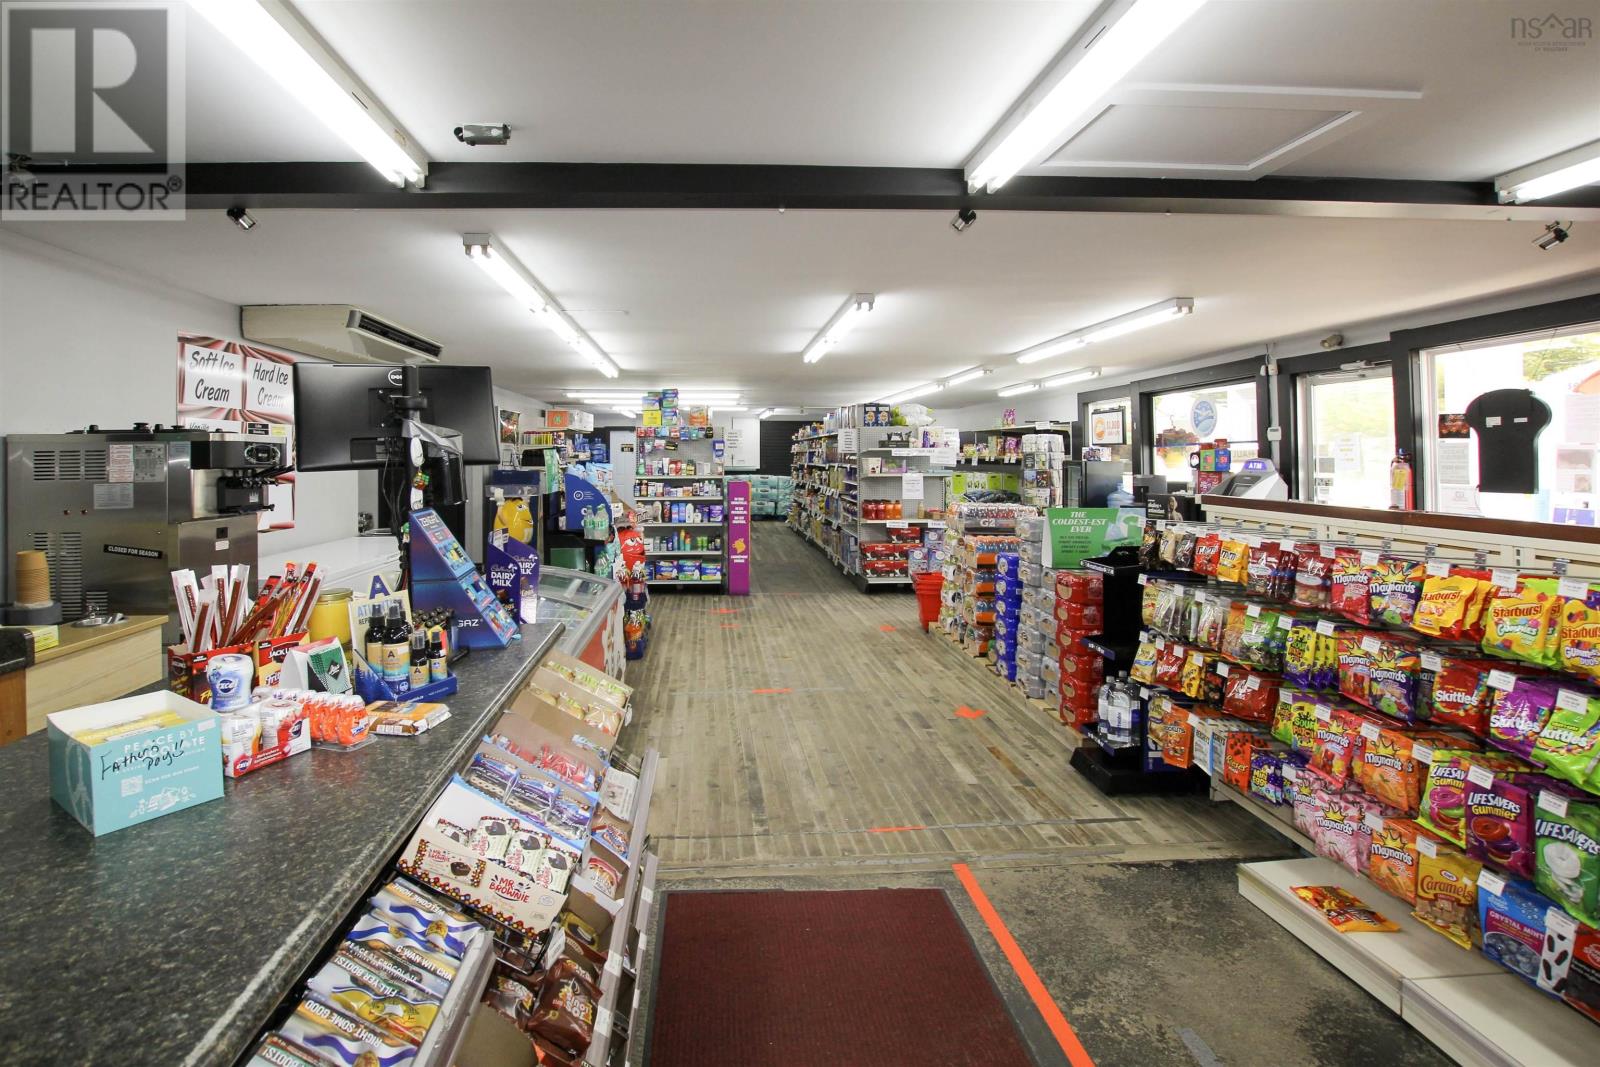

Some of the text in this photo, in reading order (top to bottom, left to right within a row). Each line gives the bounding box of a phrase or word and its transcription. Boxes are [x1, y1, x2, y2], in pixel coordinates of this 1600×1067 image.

[191, 351, 235, 372] Soft Ice
[253, 361, 289, 385] Hard Ice
[194, 378, 230, 403] Cream
[980, 519, 995, 527] G2
[1052, 518, 1108, 526] COLDEST-EST
[1070, 525, 1092, 533] EVER
[107, 545, 128, 553] CLOSED
[490, 571, 516, 581] DAIRY
[492, 578, 512, 587] MILK
[1369, 581, 1416, 595] Maynards
[1435, 690, 1479, 706] Skittles
[1431, 764, 1467, 780] LIFESAV
[1432, 775, 1465, 789] Gummi
[1467, 791, 1521, 814] LIFESAVERS
[1471, 804, 1518, 821] Gummies
[1315, 816, 1354, 836] Maynards
[1535, 818, 1600, 855] LIFESAVERS
[1371, 842, 1414, 867] Maynards
[499, 876, 515, 890] MR
[1421, 875, 1474, 900] Caramels
[488, 881, 531, 904] BROWNIE
[1489, 910, 1545, 941] CRYSTAL MINT
[304, 999, 332, 1018] GOOD
[330, 1010, 357, 1034] SOME
